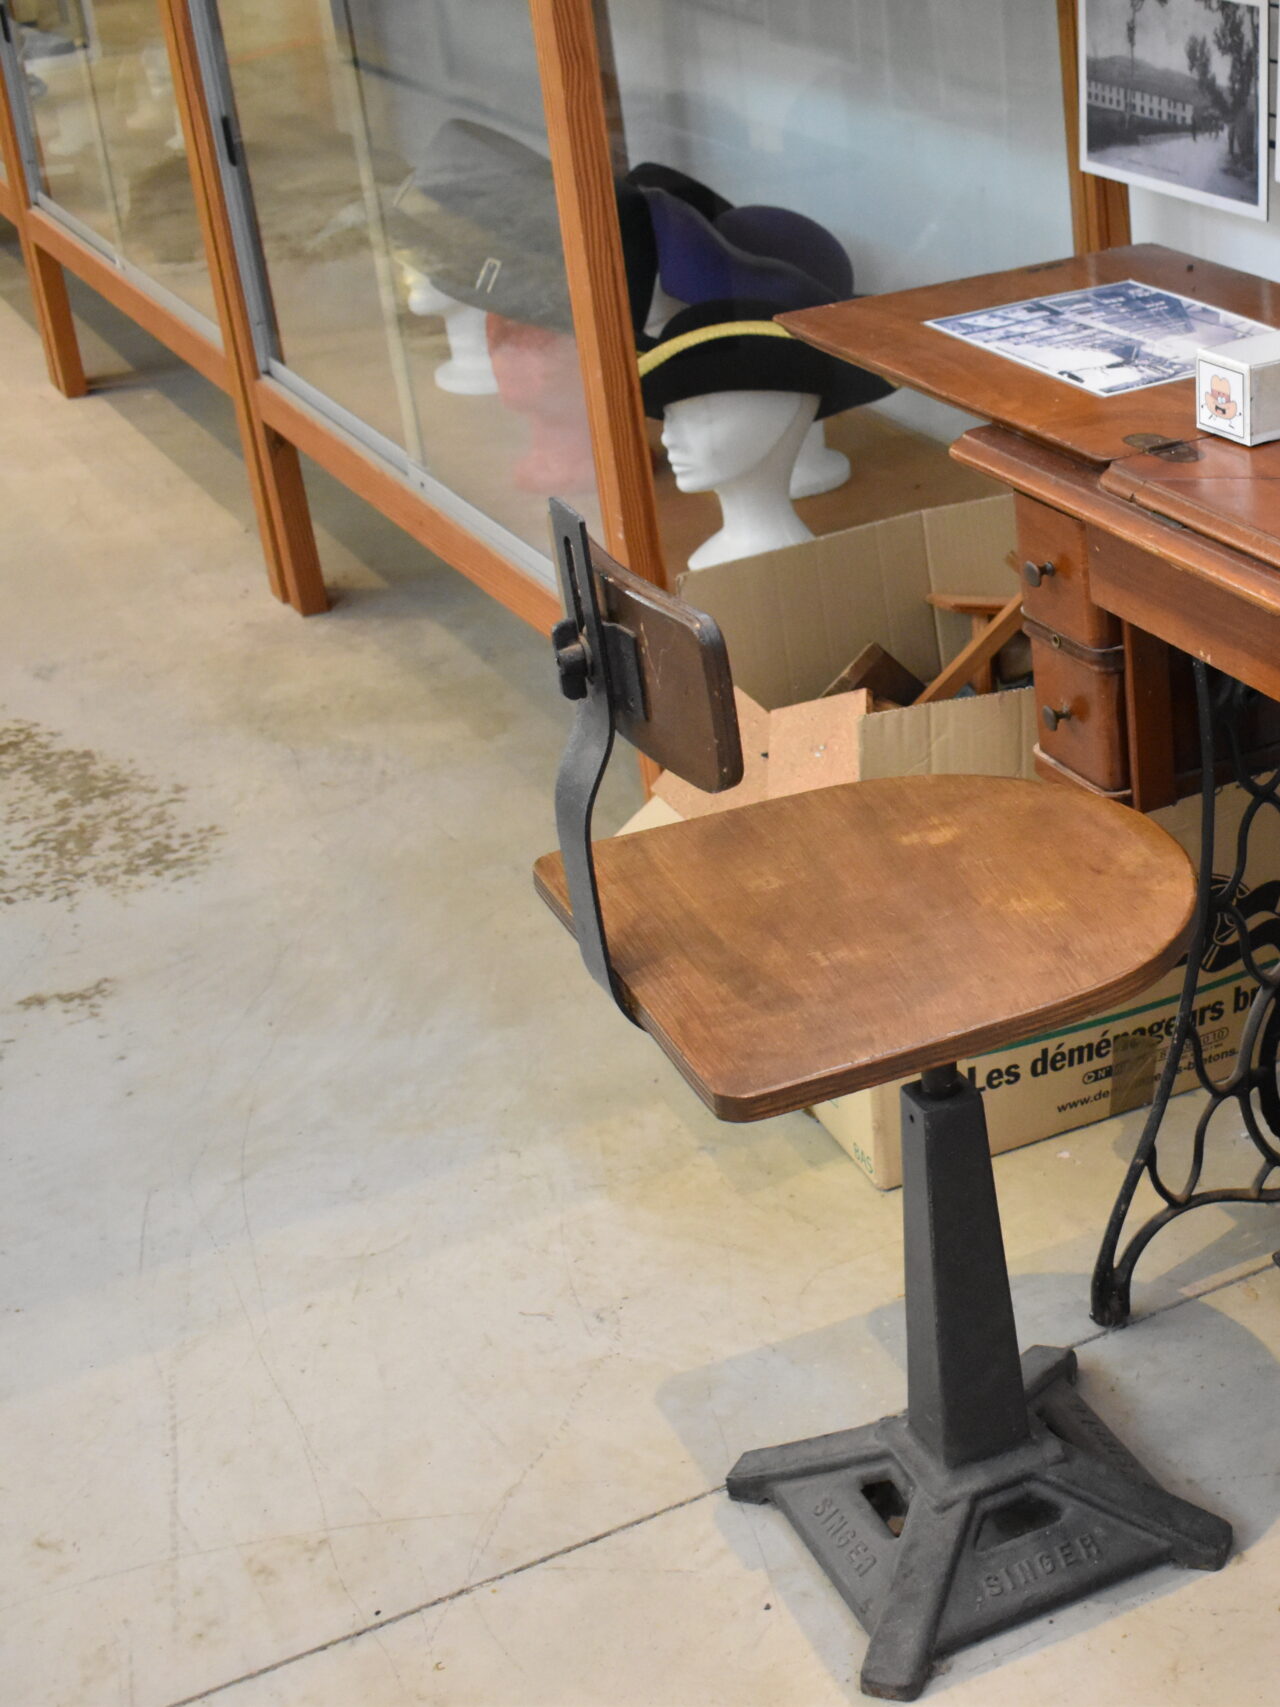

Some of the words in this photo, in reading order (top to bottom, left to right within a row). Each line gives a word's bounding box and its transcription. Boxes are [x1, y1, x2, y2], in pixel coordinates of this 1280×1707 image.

[967, 1063, 1021, 1092] Les
[811, 1497, 878, 1579] SINGER
[984, 1533, 1100, 1597] SINGER
